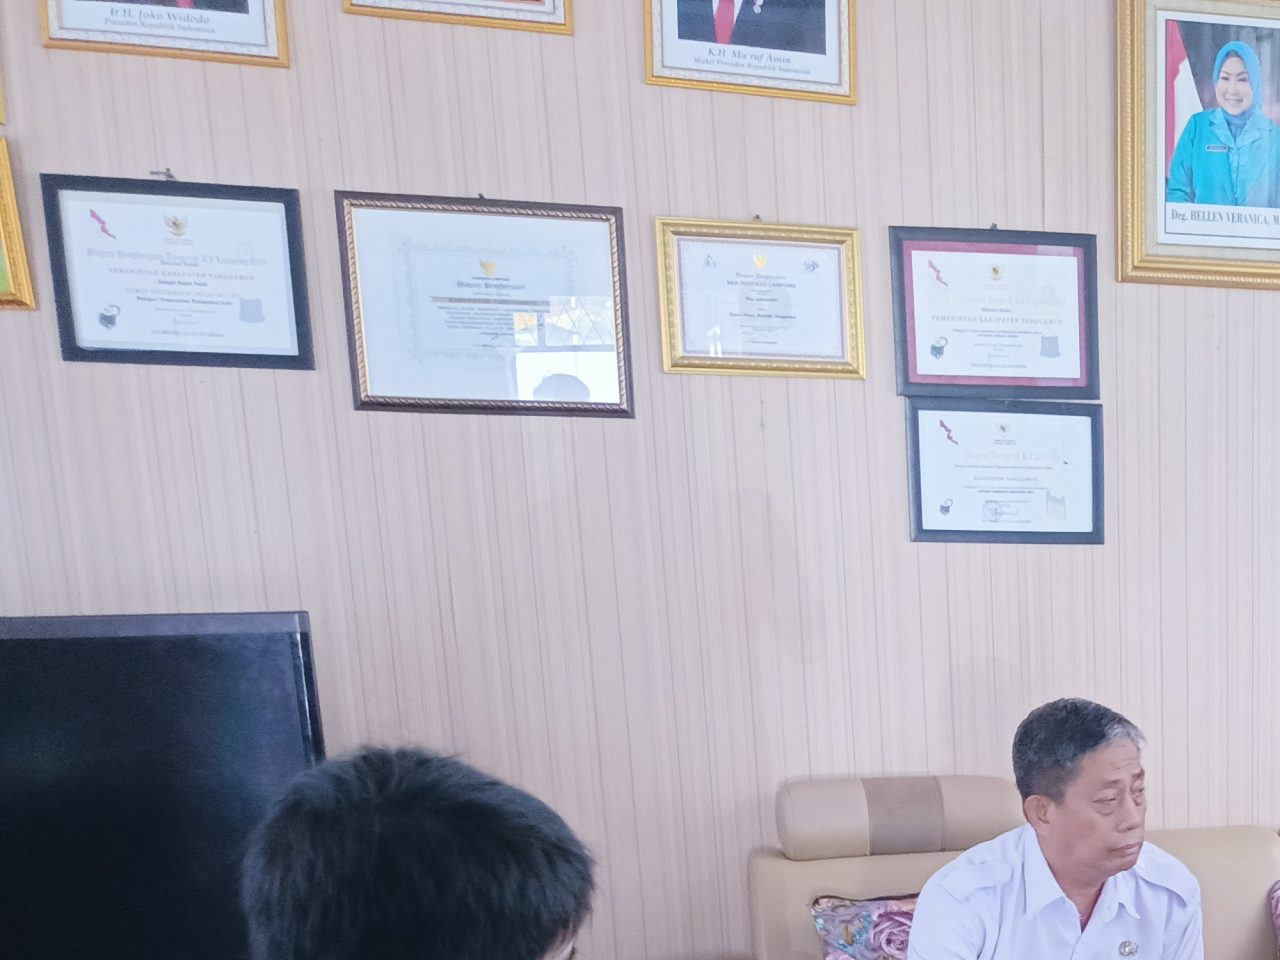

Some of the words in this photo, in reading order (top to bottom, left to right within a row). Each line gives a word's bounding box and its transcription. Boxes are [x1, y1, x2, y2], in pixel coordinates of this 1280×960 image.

[138, 9, 164, 21] Joko
[166, 11, 210, 24] Widodo
[767, 53, 792, 64] Amin
[1190, 210, 1224, 223] HELLEN
